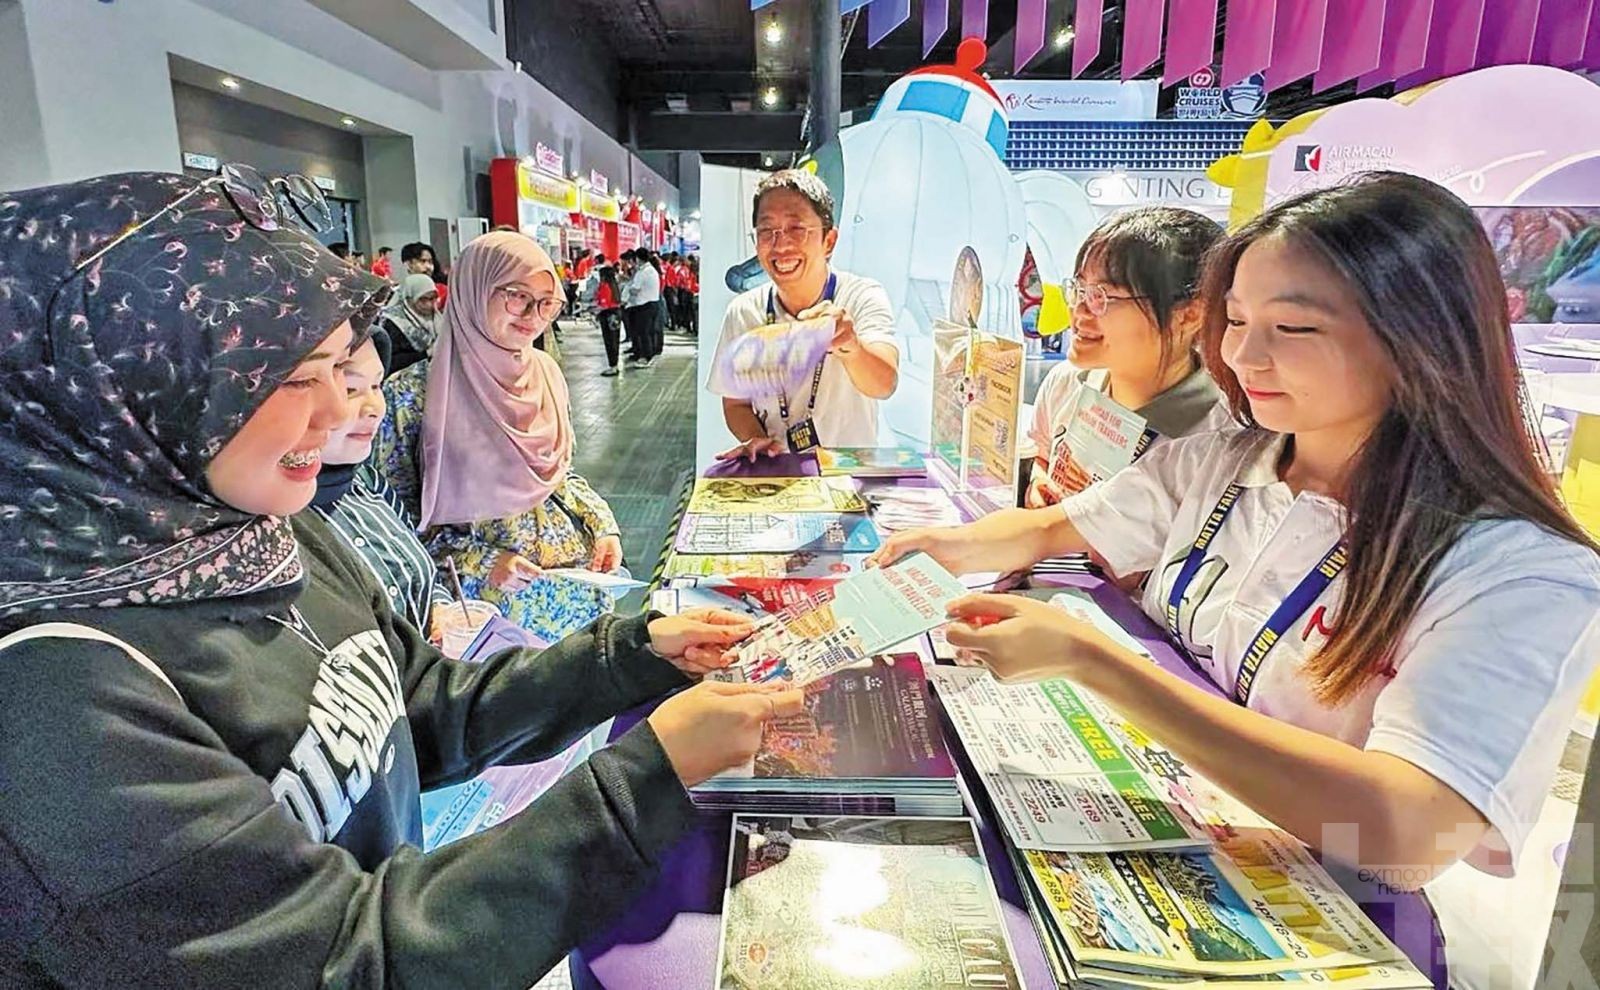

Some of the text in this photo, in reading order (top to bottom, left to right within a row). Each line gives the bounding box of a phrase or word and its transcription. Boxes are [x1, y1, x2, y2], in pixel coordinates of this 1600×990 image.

[1178, 97, 1221, 107] CRUISES
[1179, 87, 1221, 98] WORLD
[1084, 176, 1206, 200] GNTING
[1194, 483, 1241, 550] MATTA FAIR
[1236, 626, 1280, 702] MATTA FAIR
[1070, 713, 1122, 761] FREE
[1023, 796, 1046, 825] 2249
[1076, 796, 1101, 824] 2169
[1120, 787, 1157, 822] FREE
